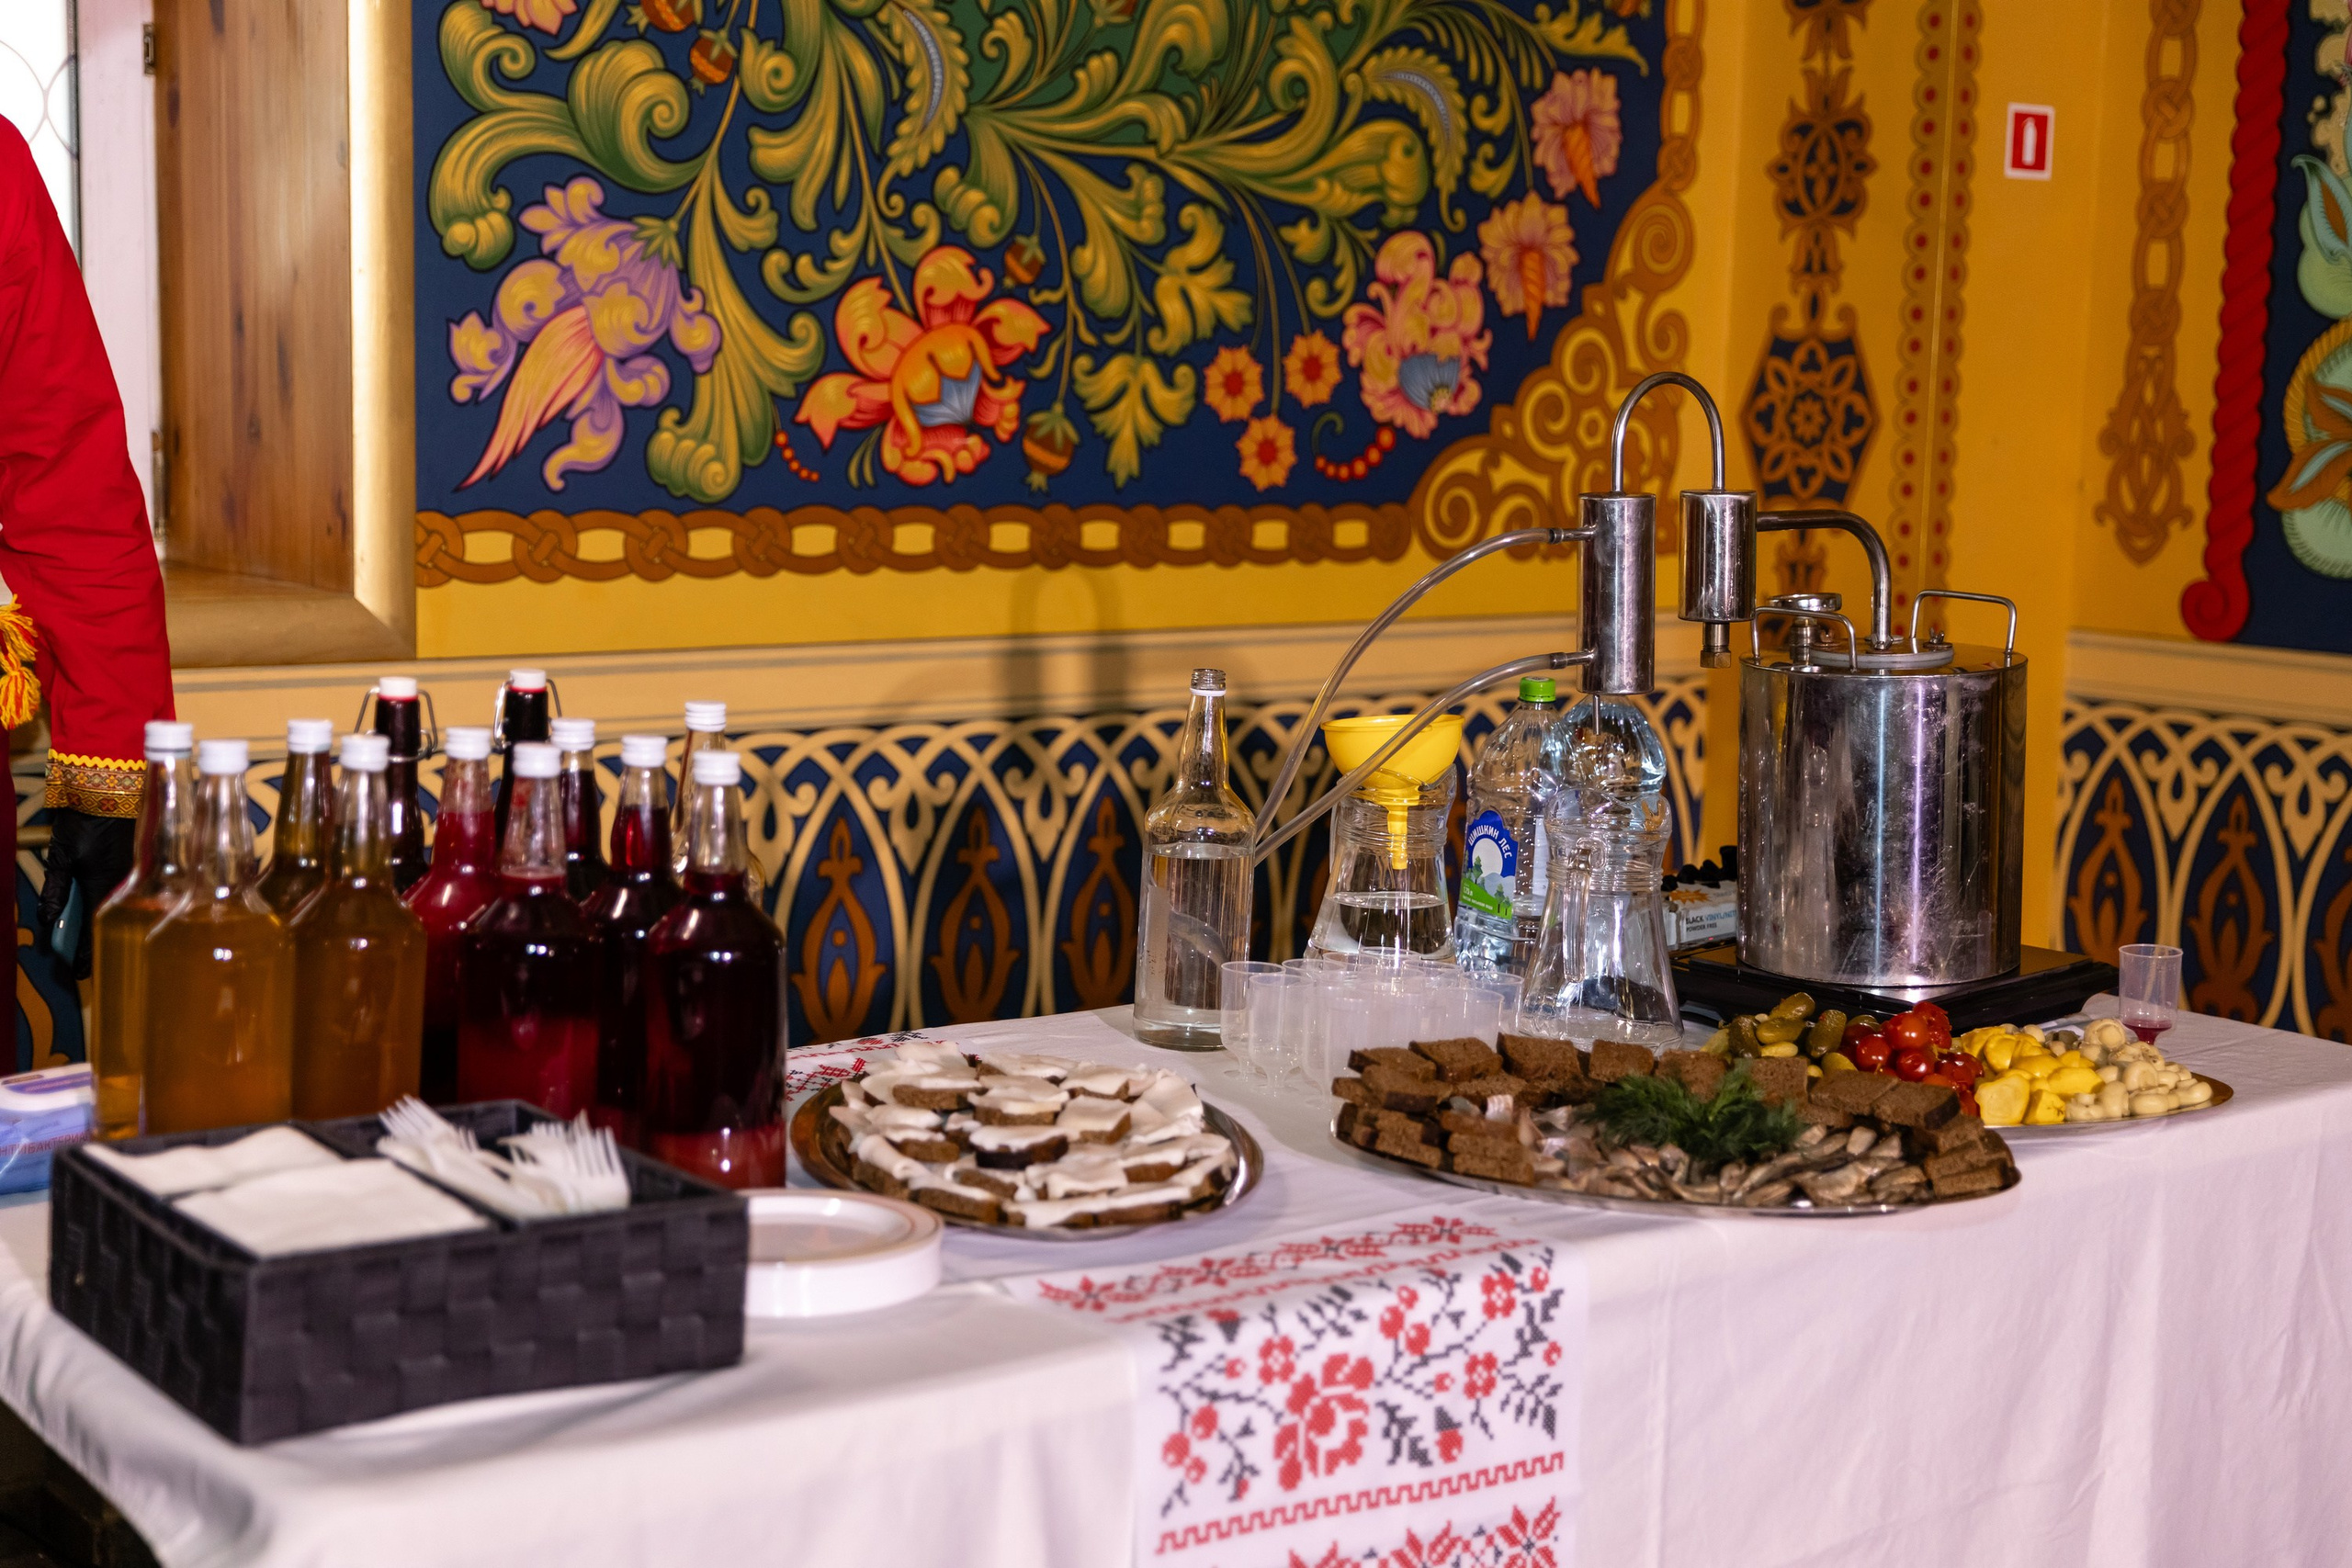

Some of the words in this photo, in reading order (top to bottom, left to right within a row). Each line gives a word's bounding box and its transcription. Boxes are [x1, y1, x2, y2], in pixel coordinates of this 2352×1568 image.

[1468, 825, 1499, 846] ШИШКИН
[1498, 838, 1512, 858] ЛЕС
[1686, 915, 1704, 925] BLACK
[1686, 924, 1706, 932] POWDER
